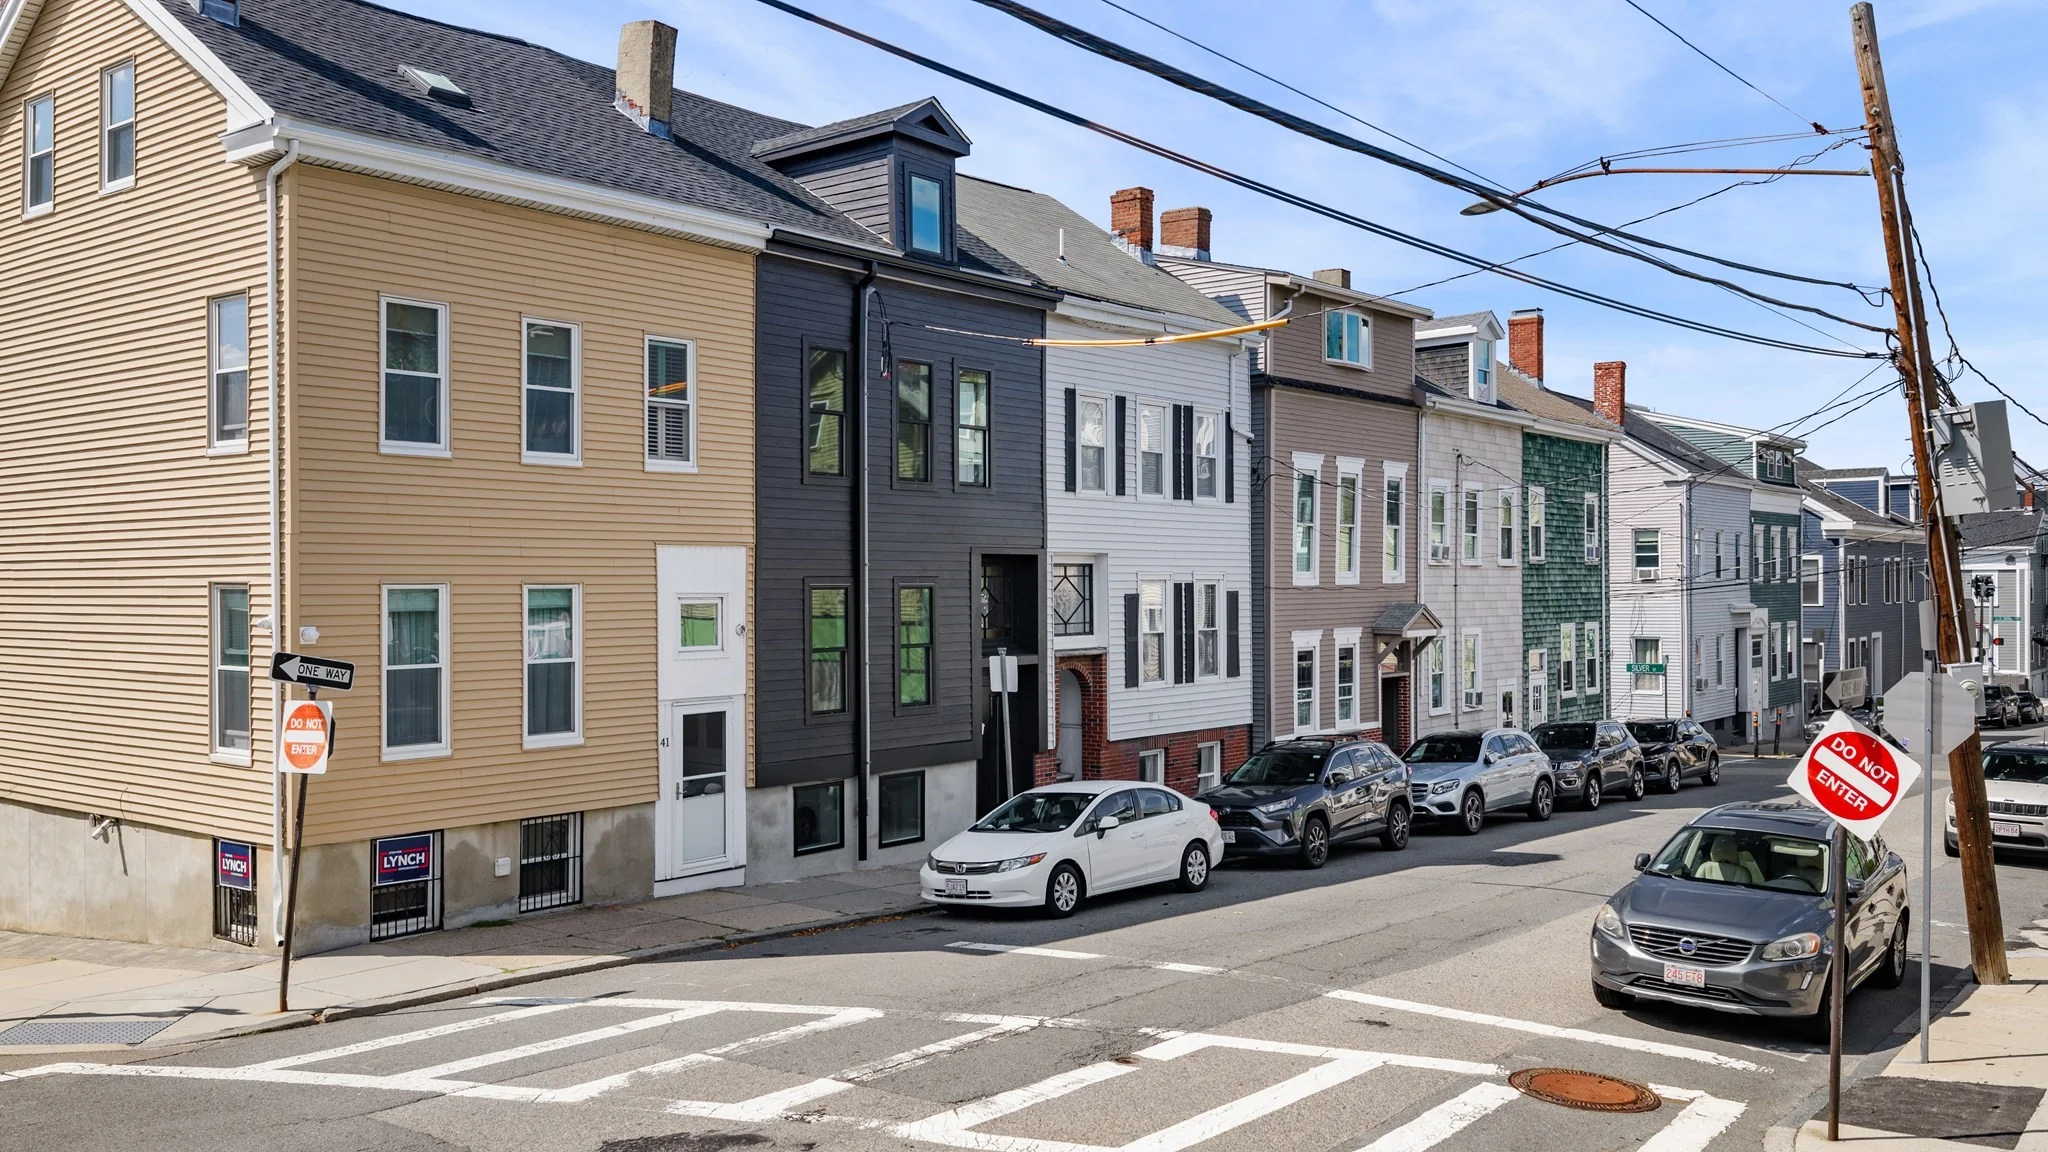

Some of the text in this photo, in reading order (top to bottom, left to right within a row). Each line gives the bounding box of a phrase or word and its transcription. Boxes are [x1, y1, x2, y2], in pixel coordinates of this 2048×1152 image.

[298, 664, 347, 681] ONE WAY
[1631, 664, 1650, 672] SILVER
[290, 718, 323, 729] DO NOT
[291, 744, 317, 755] ENTER
[660, 737, 669, 747] 41
[1831, 736, 1895, 785] DO NOT
[1815, 768, 1868, 812] ENTER
[222, 858, 247, 873] LYNCH
[383, 852, 425, 868] LYNCH
[1666, 968, 1683, 981] 245
[1685, 971, 1703, 984] ET8
